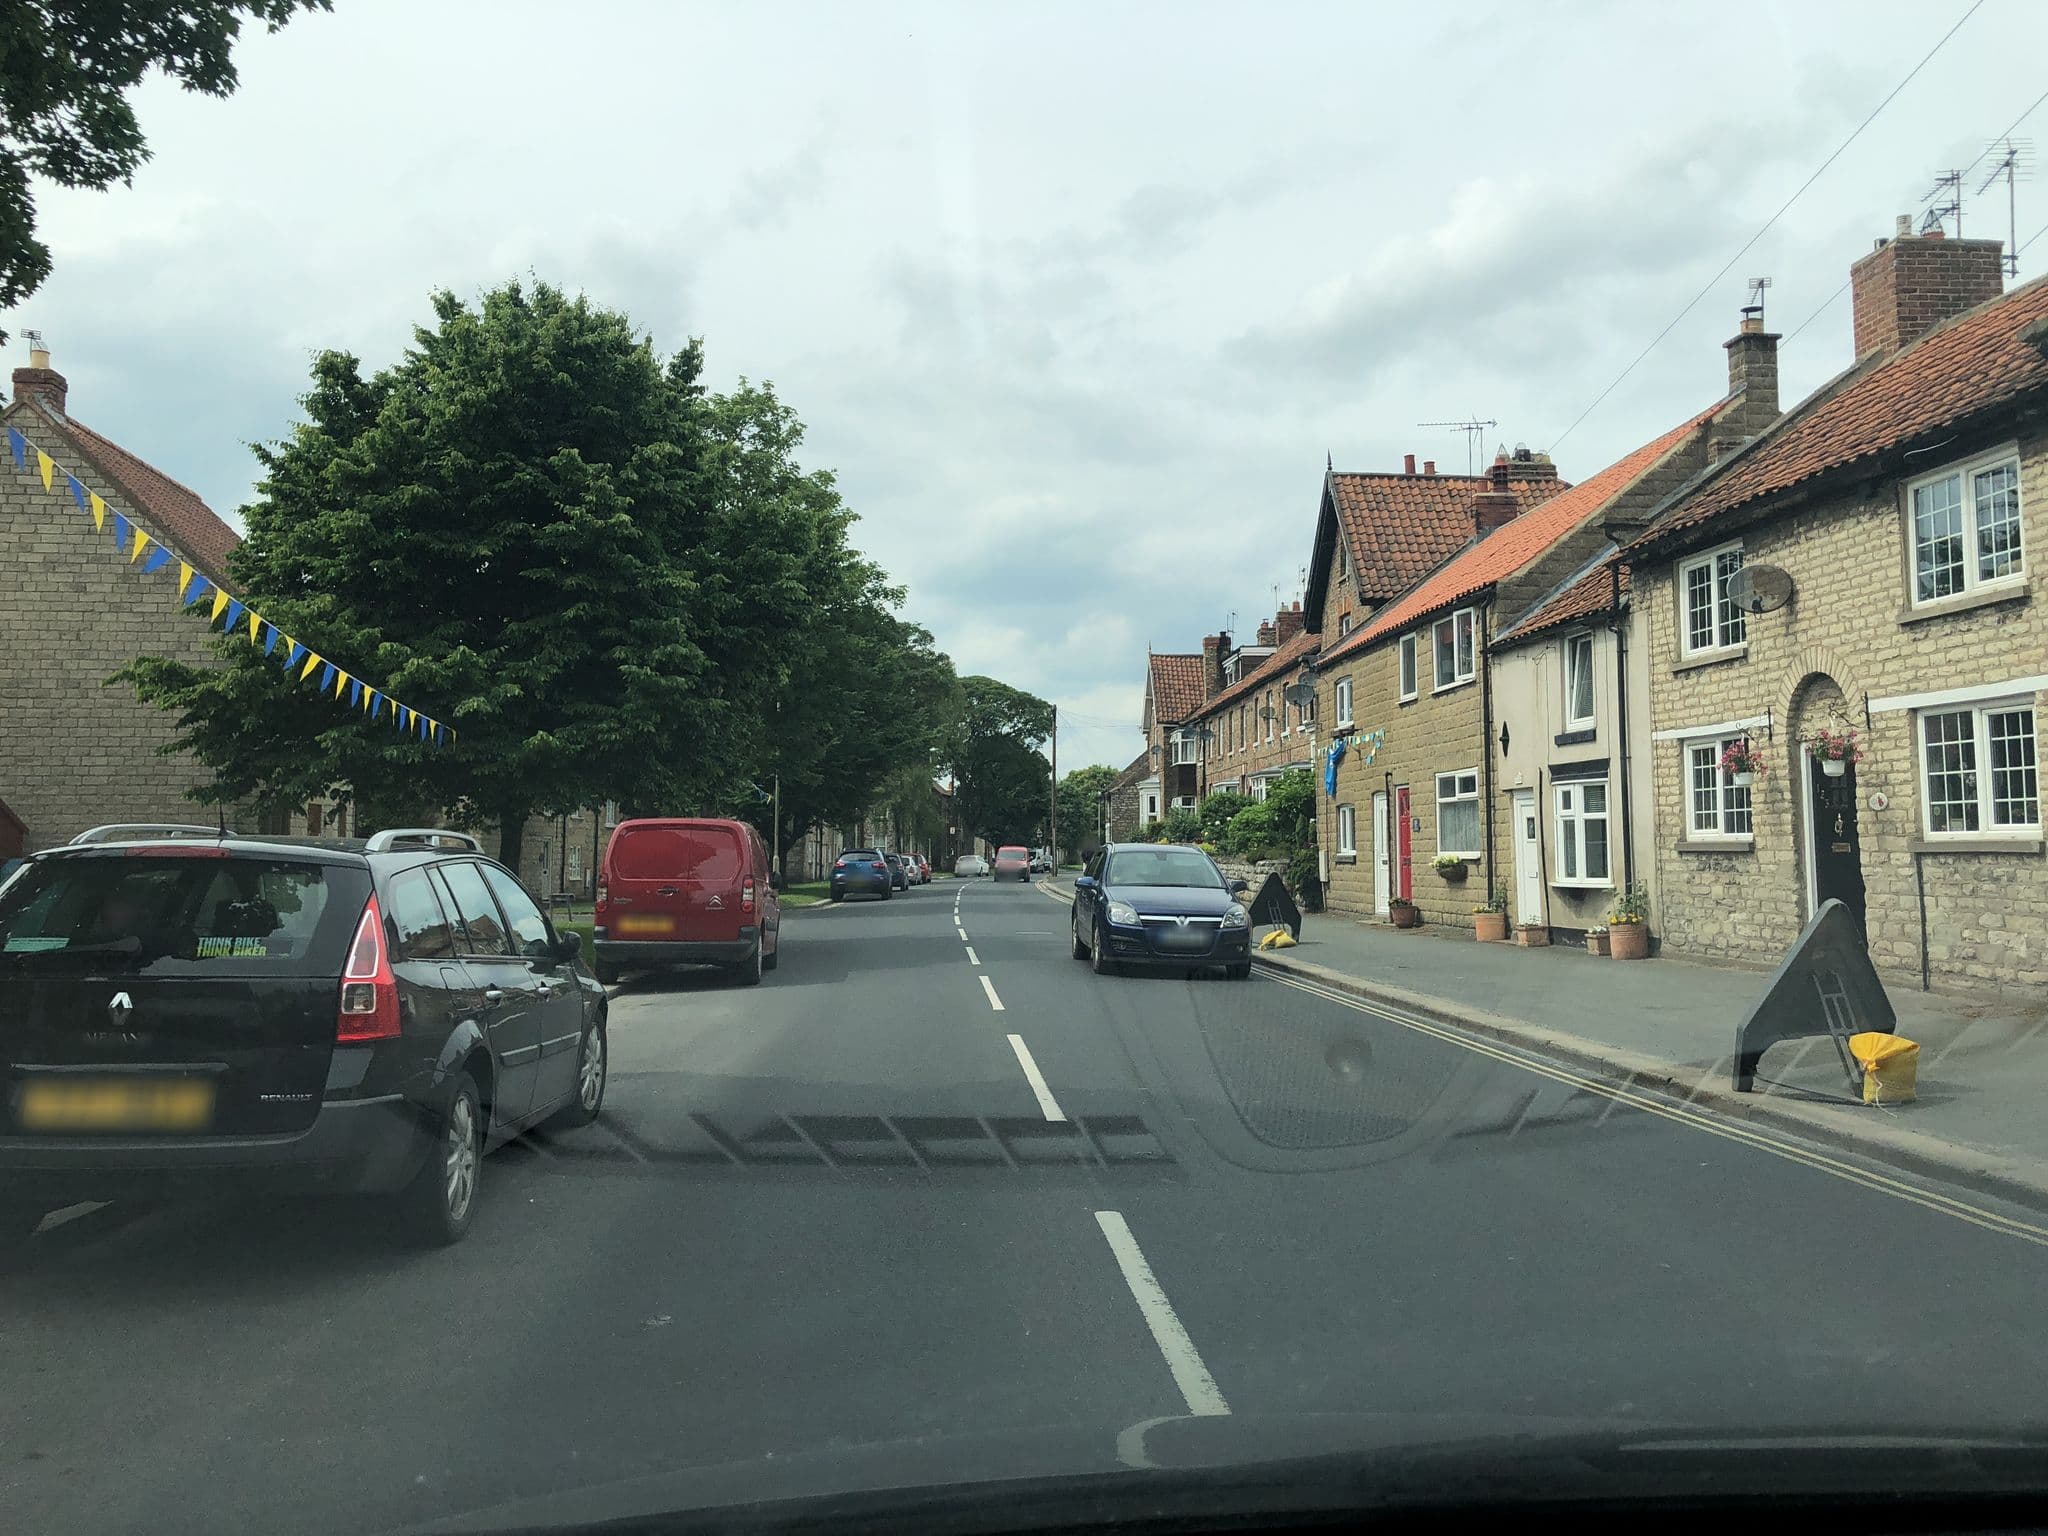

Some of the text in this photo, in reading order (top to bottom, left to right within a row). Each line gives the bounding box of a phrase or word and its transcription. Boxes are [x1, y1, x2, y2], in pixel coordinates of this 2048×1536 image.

[198, 937, 262, 947] THINK BIKE
[196, 946, 268, 957] THINK BIKER
[260, 1094, 313, 1102] RENAULT
